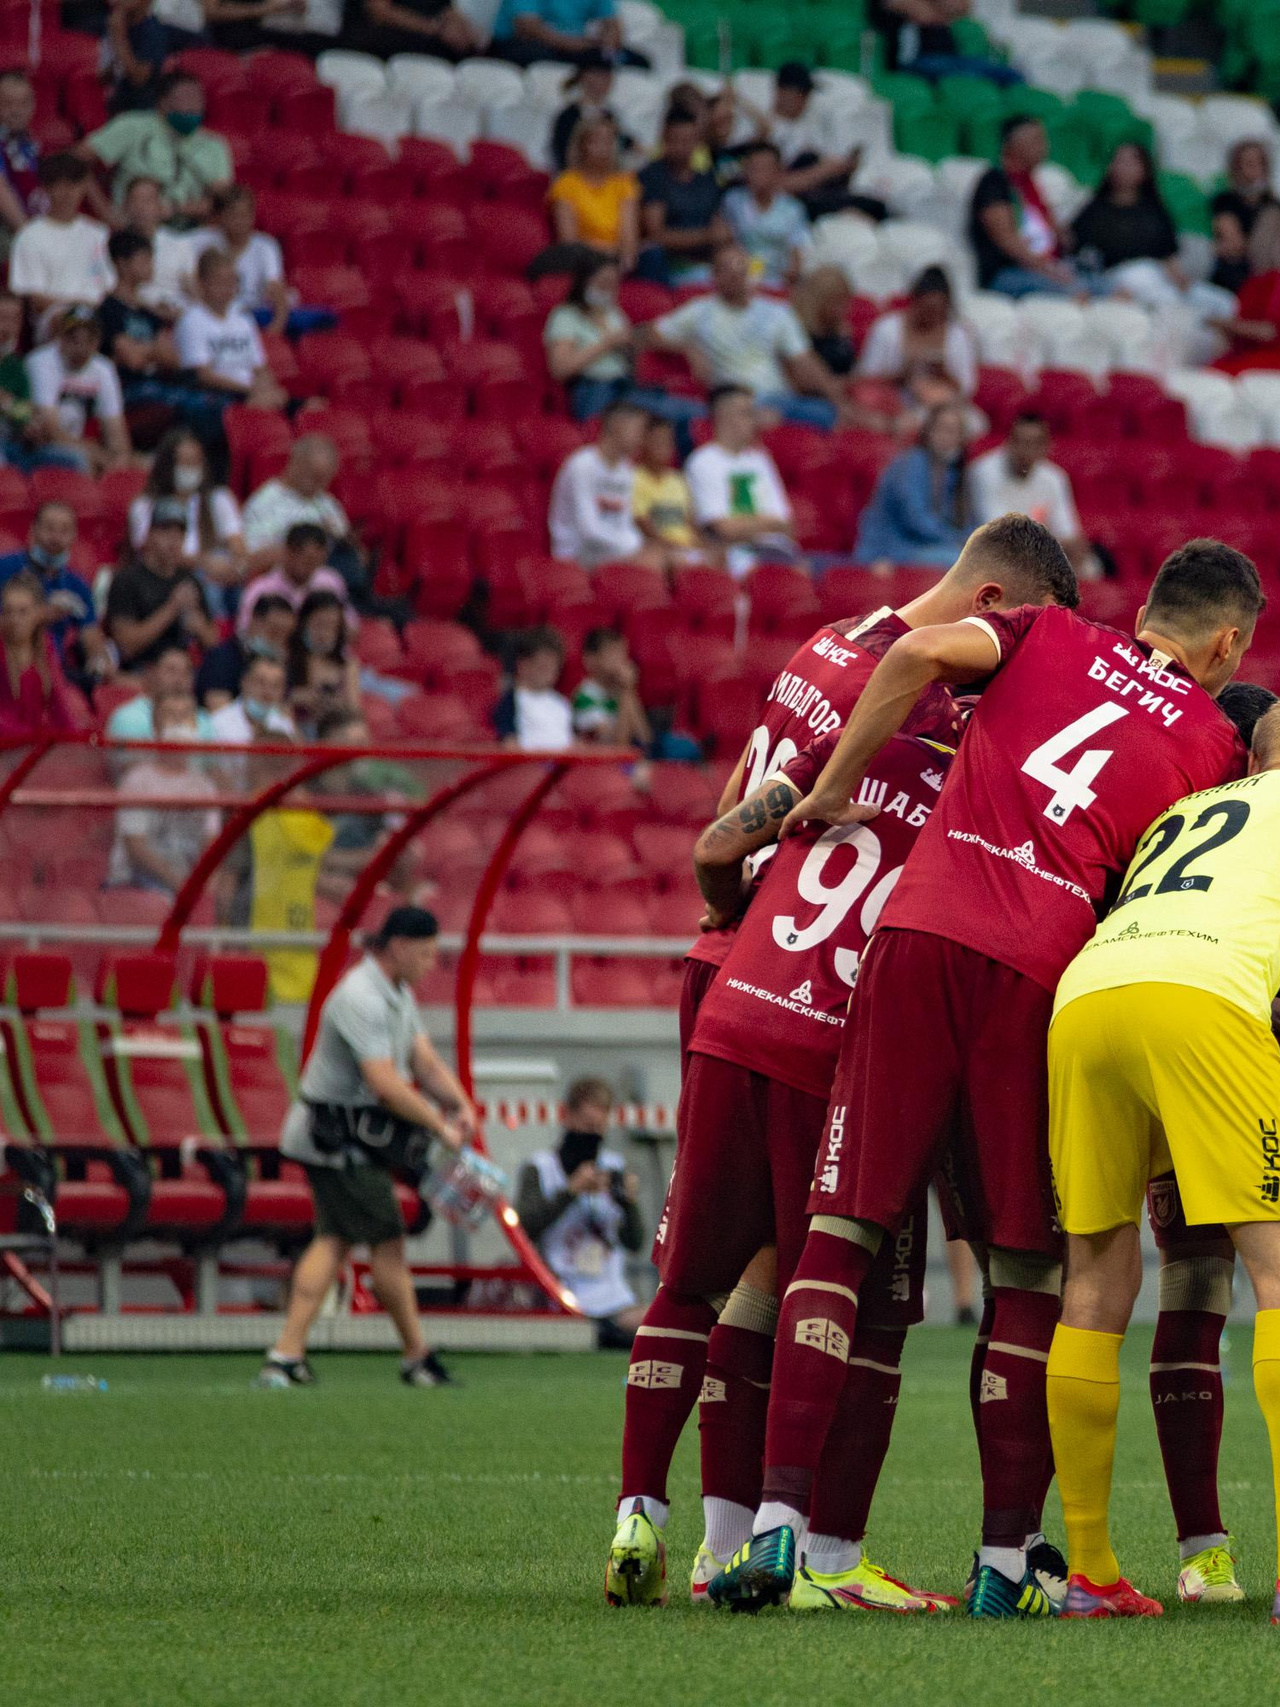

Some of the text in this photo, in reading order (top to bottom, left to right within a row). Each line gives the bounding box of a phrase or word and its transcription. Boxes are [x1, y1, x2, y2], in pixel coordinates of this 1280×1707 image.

[767, 671, 841, 736] ИЛЬДГОР
[1087, 656, 1183, 727] БЕГИЧ
[1020, 701, 1130, 826] 4
[850, 777, 932, 827] ШАБ
[947, 830, 1091, 904] НИЖНЕКАМСКНЕФТЕХ
[1108, 800, 1250, 917] 22
